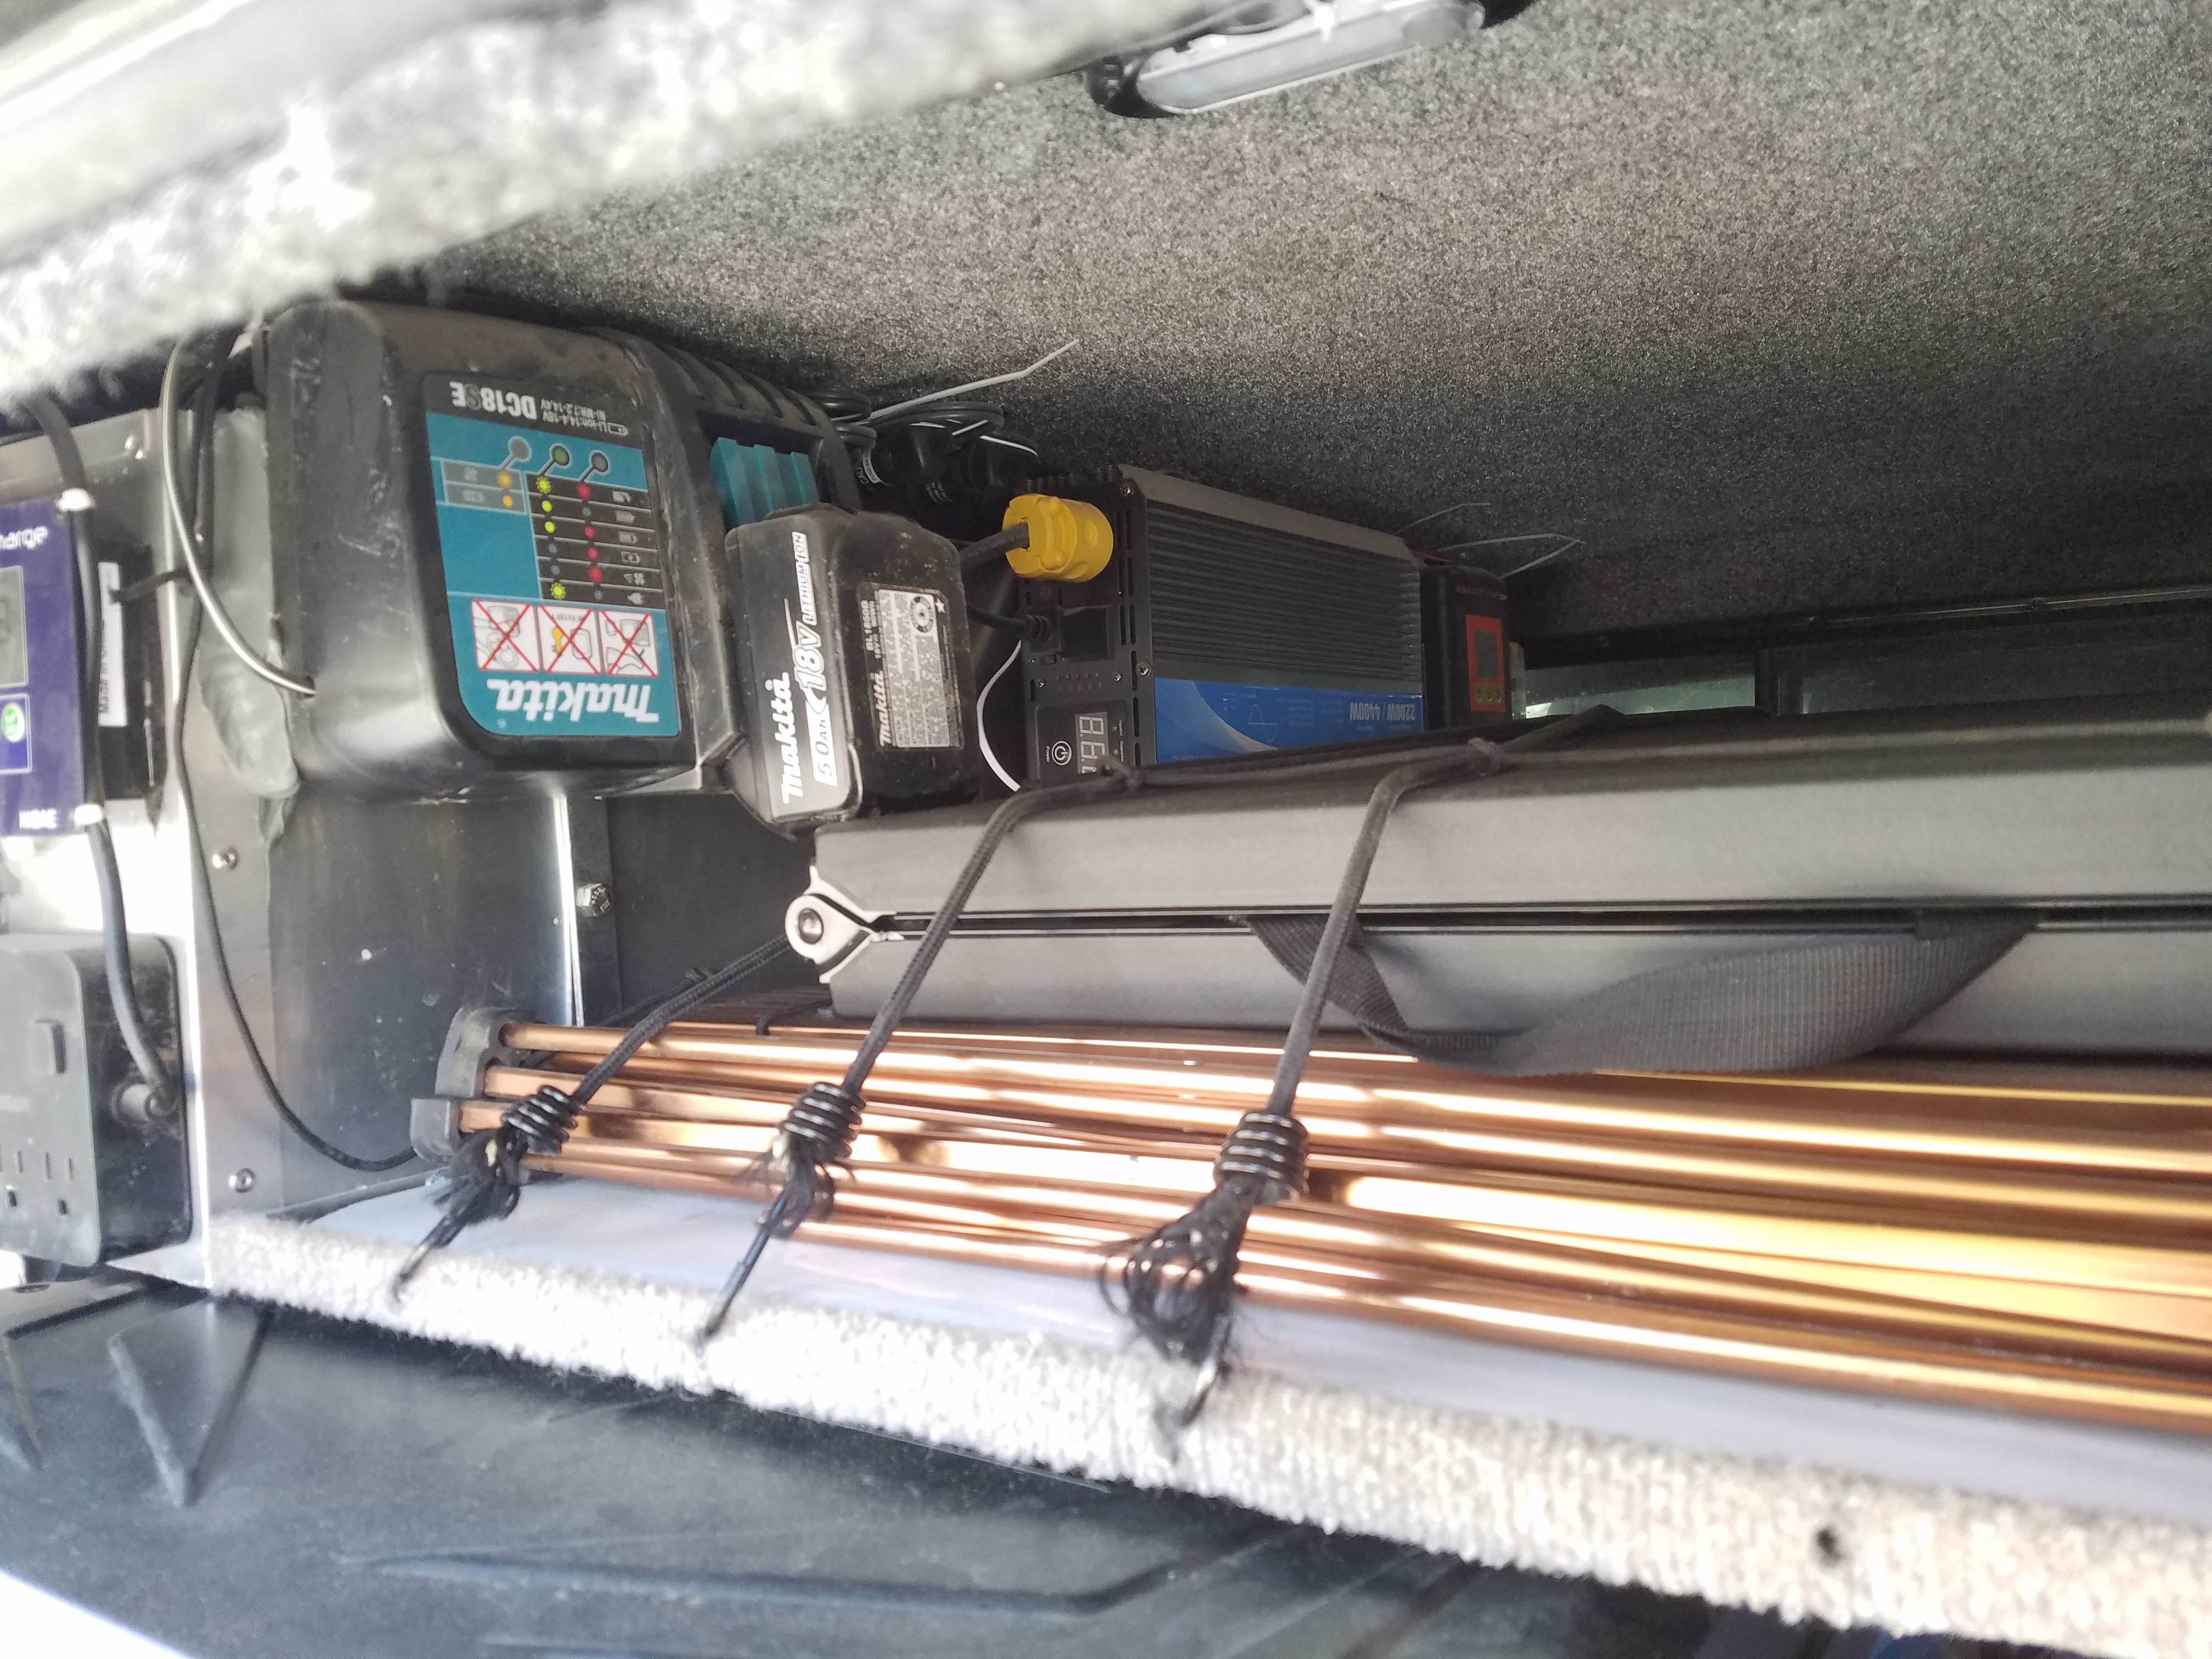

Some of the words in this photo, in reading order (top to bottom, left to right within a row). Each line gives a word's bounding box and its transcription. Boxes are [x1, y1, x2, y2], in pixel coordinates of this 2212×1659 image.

[449, 381, 538, 420] DC18SE
[793, 532, 816, 625] LITHIUM-ION
[793, 620, 827, 692] 18V
[1350, 702, 1381, 721] 4400W
[1387, 703, 1415, 721] 2200W
[815, 719, 832, 776] 50Ah
